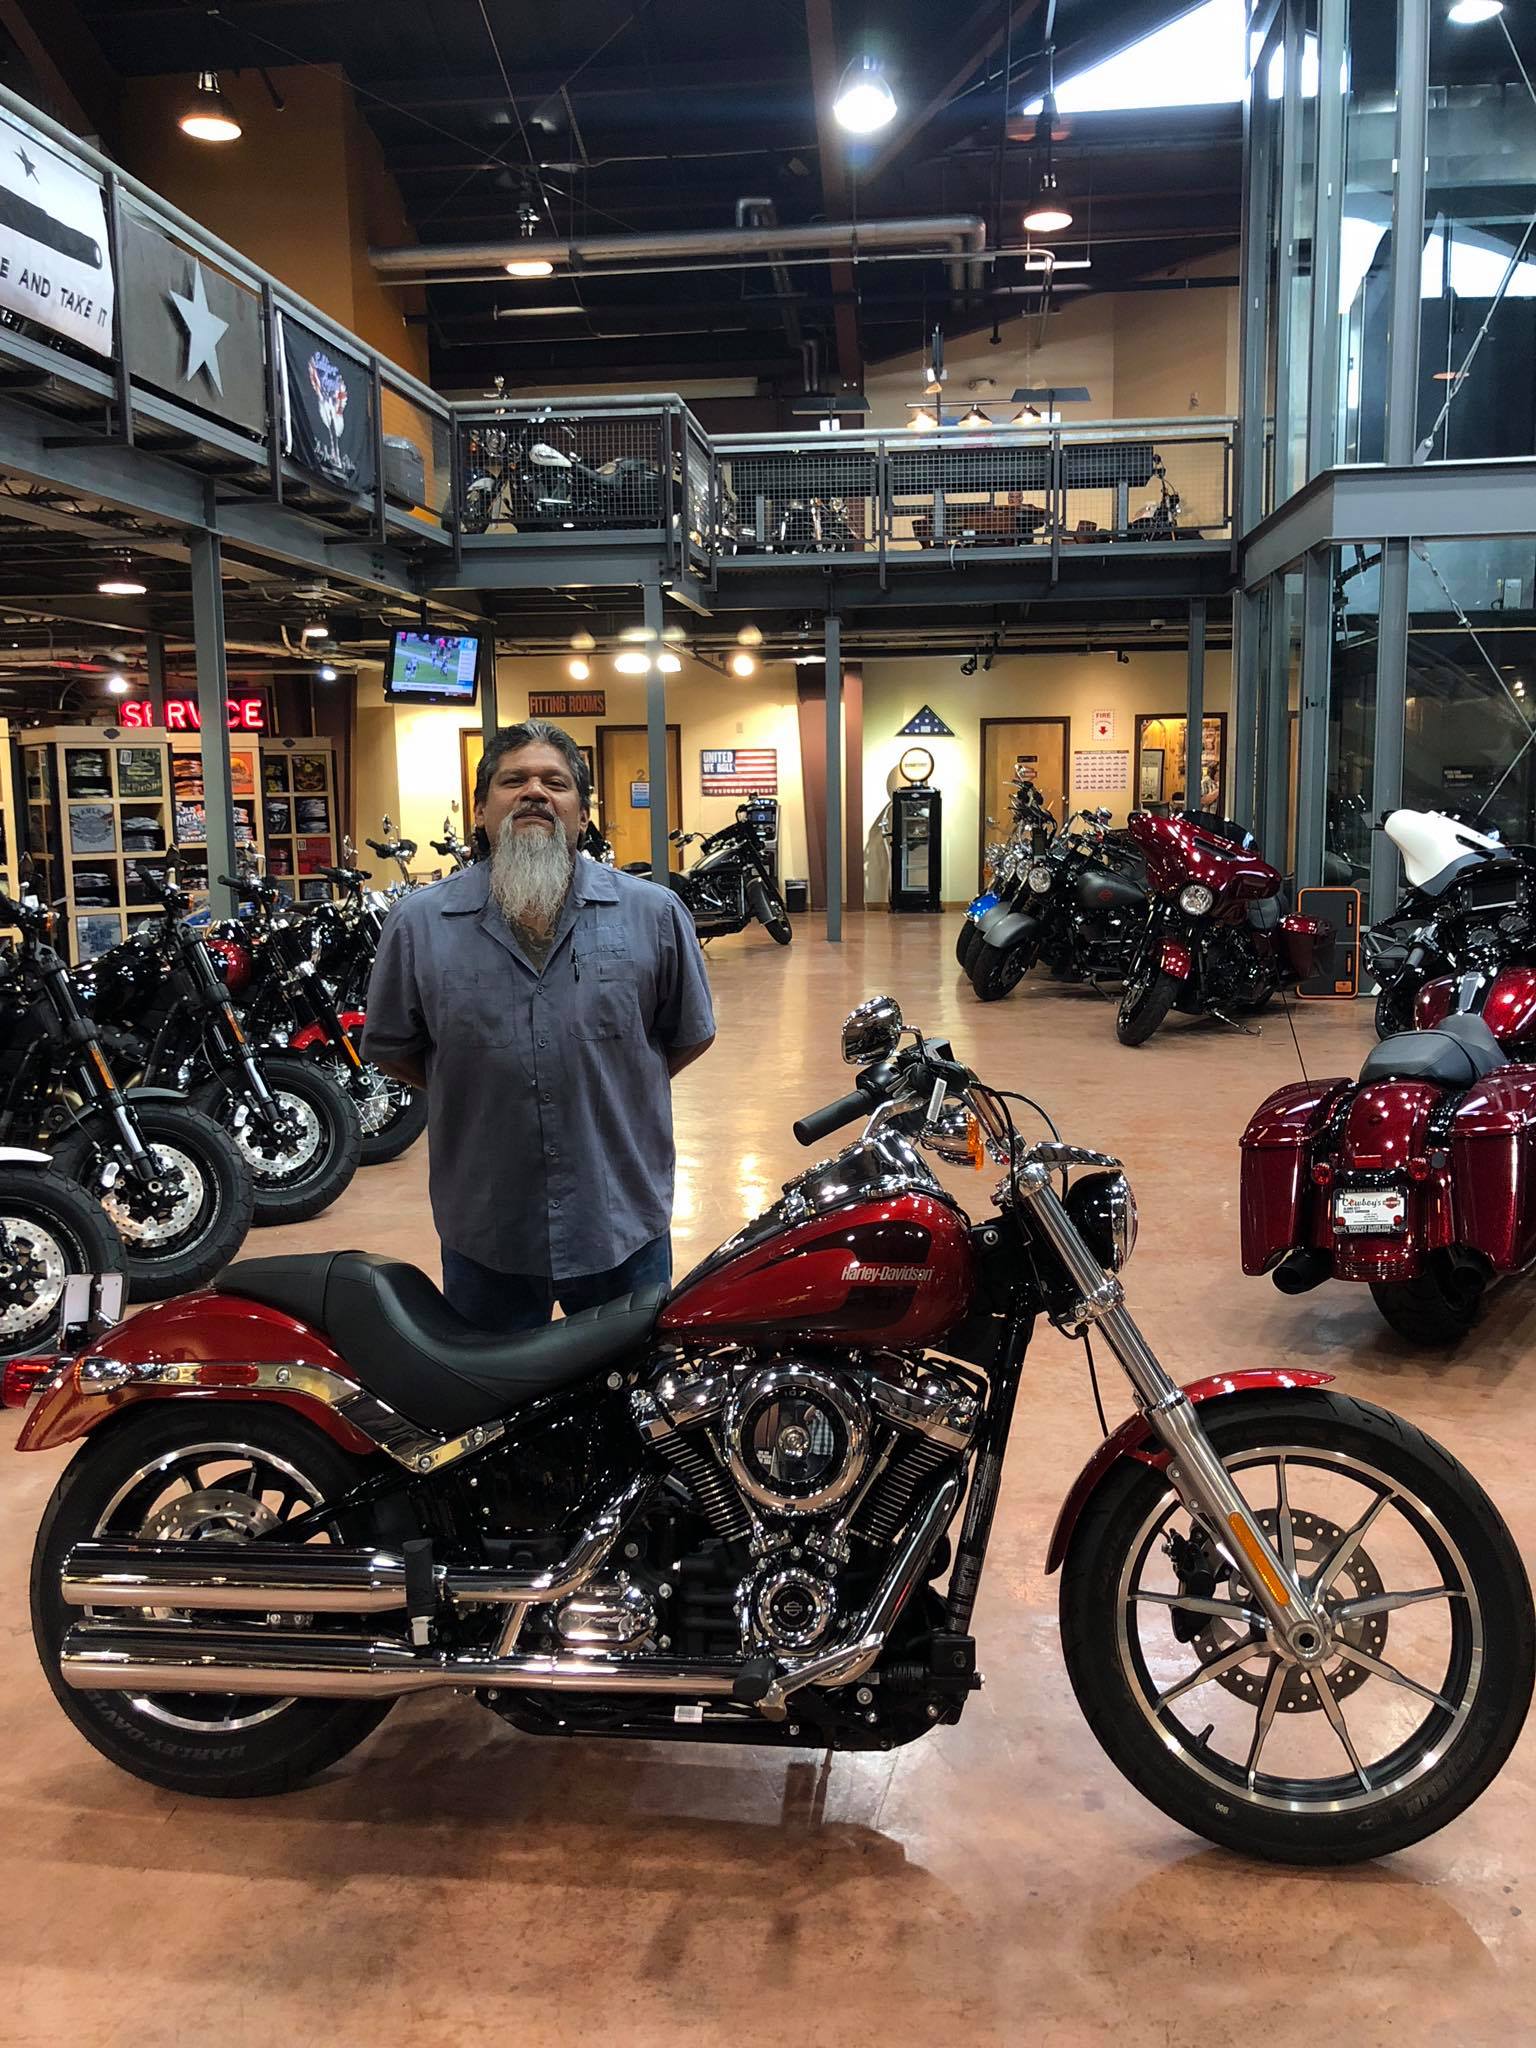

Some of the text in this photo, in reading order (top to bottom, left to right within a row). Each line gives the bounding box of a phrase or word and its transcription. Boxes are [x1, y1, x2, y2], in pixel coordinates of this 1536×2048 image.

[18, 268, 51, 298] AND
[60, 287, 93, 318] TAKE
[97, 307, 108, 328] IT
[530, 695, 604, 713] FITTING ROOMS
[121, 700, 263, 728] SRVCE
[703, 751, 733, 763] UNITED
[636, 768, 645, 781] 2
[703, 763, 715, 773] WE
[841, 1265, 934, 1282] Harley-Davidson
